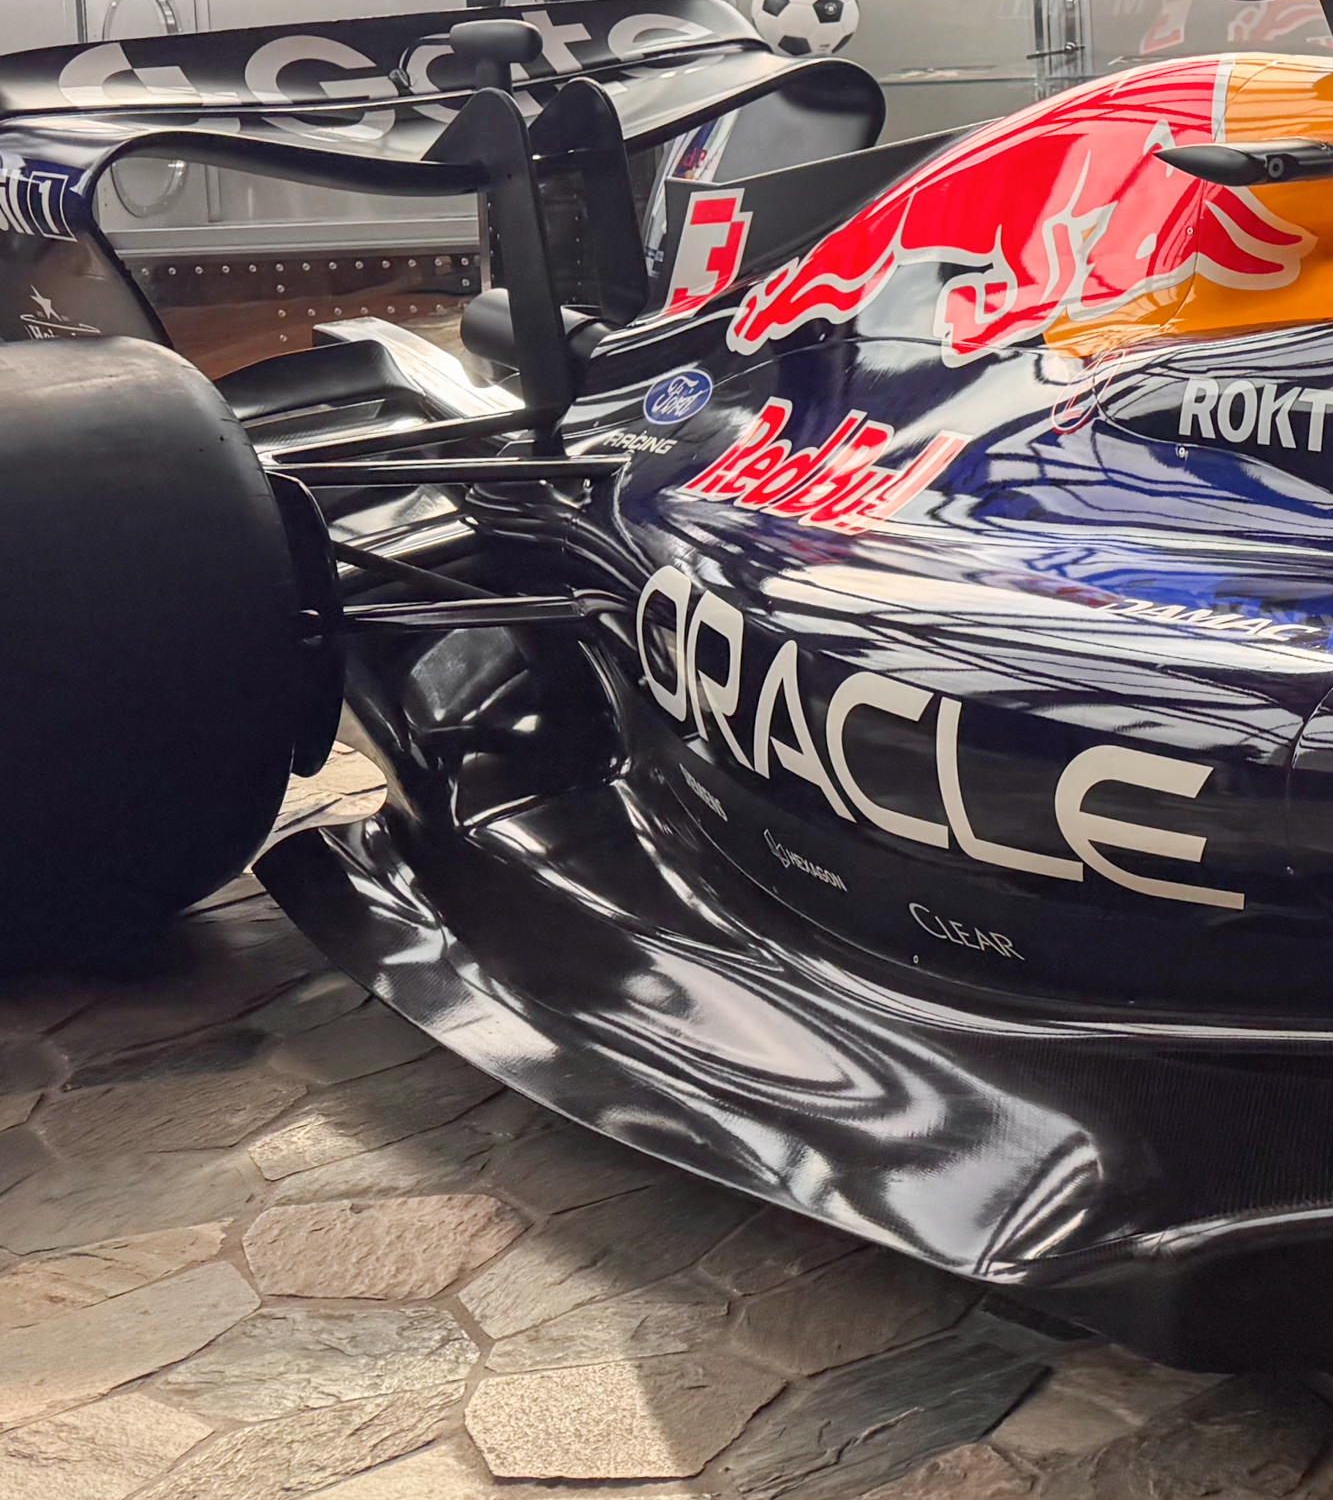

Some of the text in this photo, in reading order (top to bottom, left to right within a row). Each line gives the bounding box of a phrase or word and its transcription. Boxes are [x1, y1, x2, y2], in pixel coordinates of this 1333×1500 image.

[653, 375, 700, 416] Ford
[603, 433, 678, 455] RACING
[1097, 599, 1322, 642] DAMAC
[636, 565, 1245, 911] ORACLE
[785, 847, 848, 892] HEXAGON
